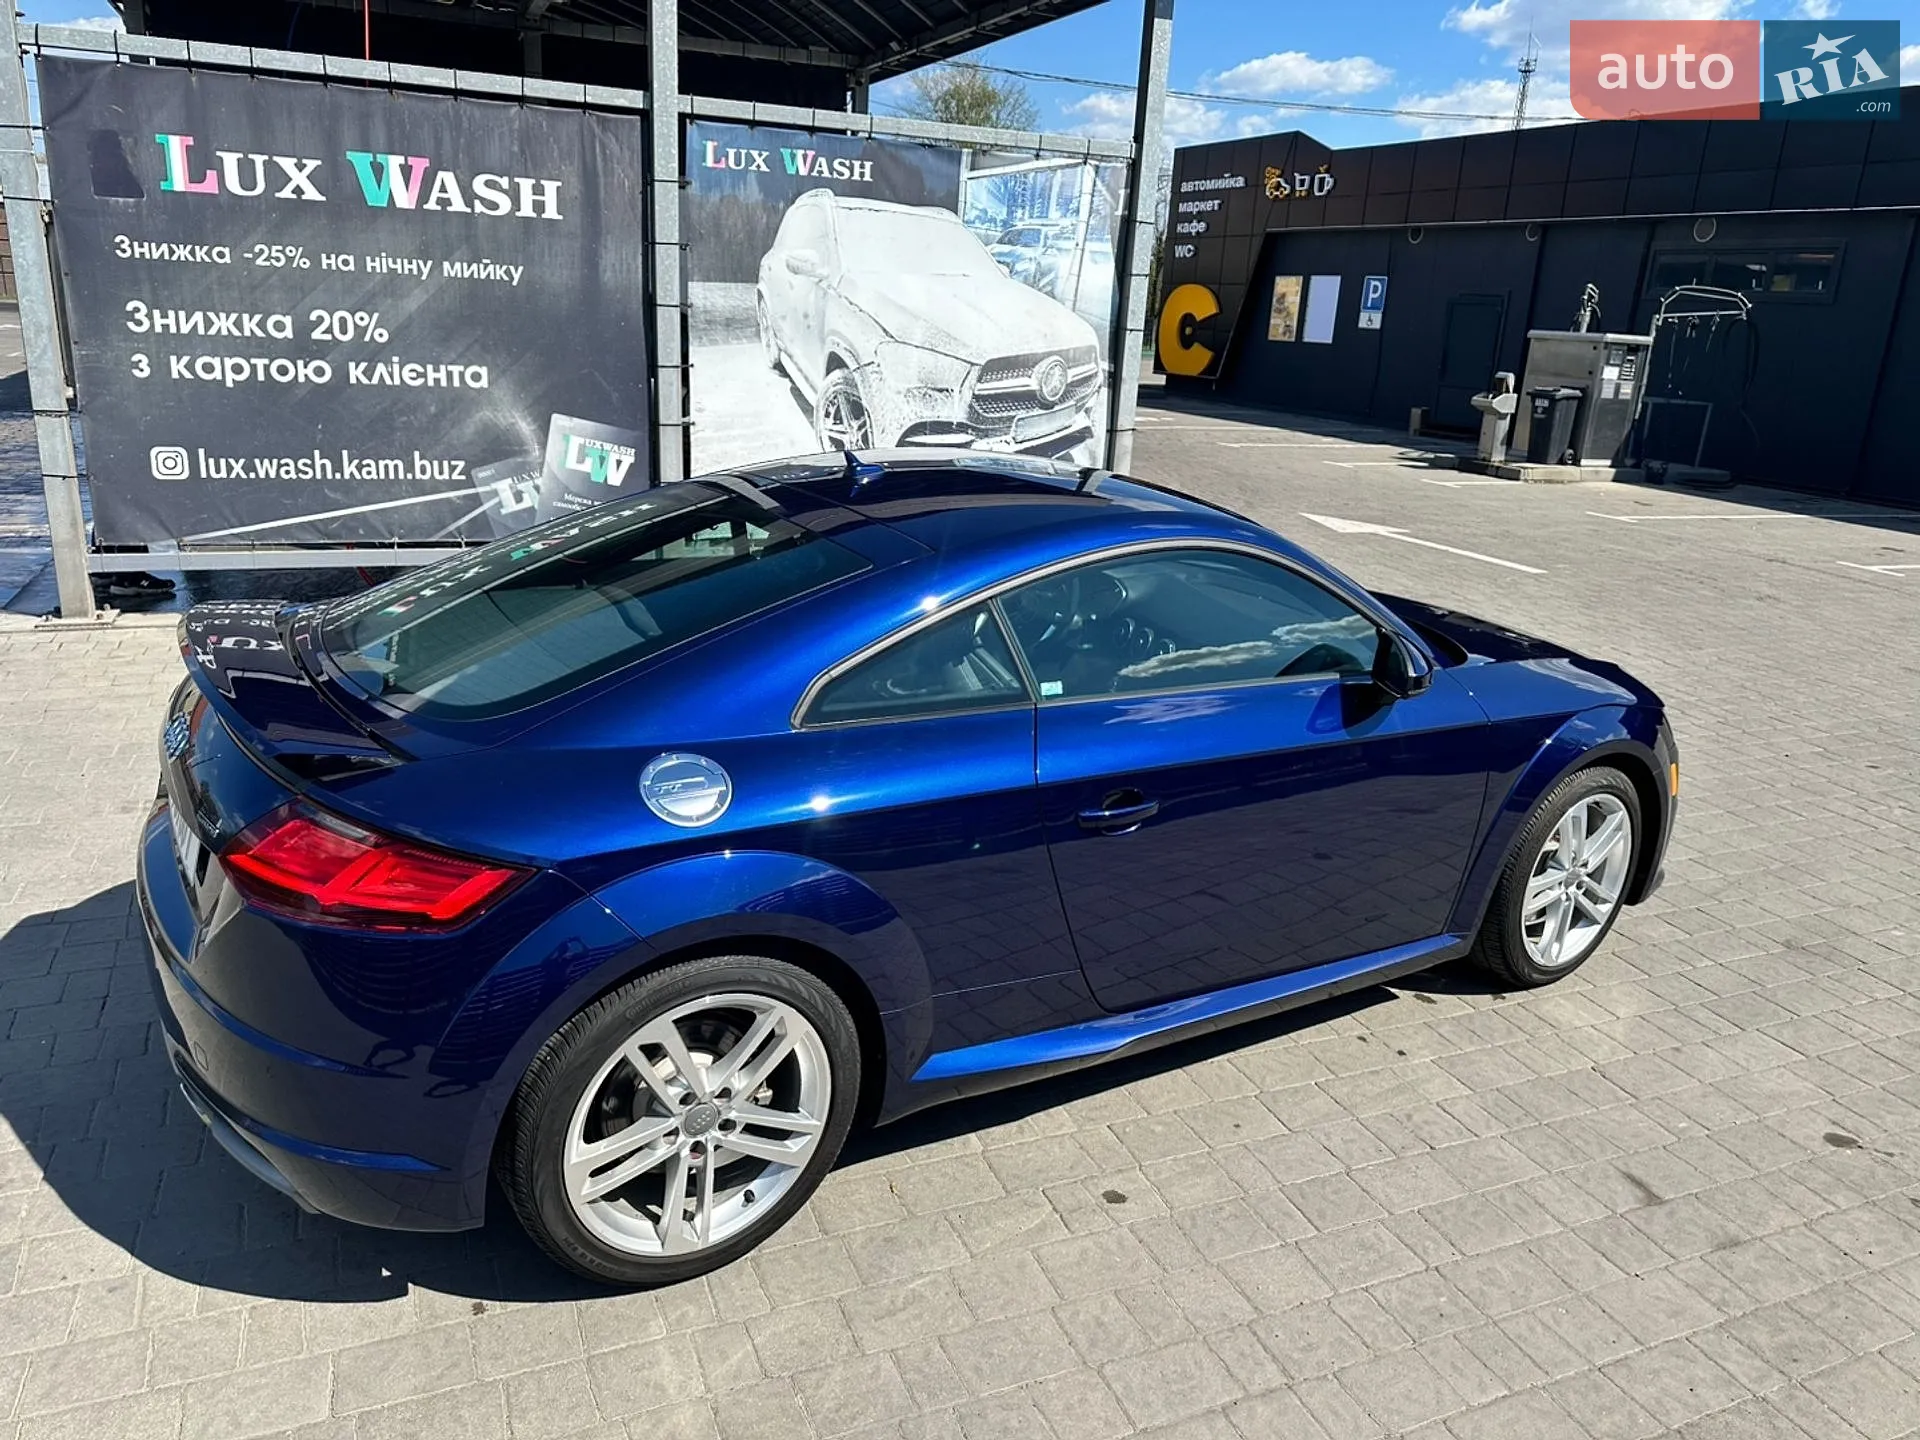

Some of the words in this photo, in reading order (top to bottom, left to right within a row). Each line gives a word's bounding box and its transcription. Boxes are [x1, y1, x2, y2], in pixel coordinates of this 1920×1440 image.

[155, 134, 326, 202] LUX
[346, 150, 565, 220] WASH
[702, 140, 770, 172] LUX
[780, 147, 874, 182] WASH
[1180, 172, 1246, 192] автомийка
[1178, 199, 1221, 214] маркет
[1176, 219, 1207, 236] кафе
[113, 234, 232, 264] Знижка
[242, 244, 311, 269] -25%
[320, 252, 356, 272] на
[365, 251, 434, 280] нічну
[441, 257, 525, 286] мийку
[1174, 244, 1196, 258] WC
[1367, 280, 1382, 308] P
[124, 300, 294, 340] Знижка
[308, 309, 389, 343] 20%
[130, 352, 151, 379] з
[169, 352, 333, 388] картою
[347, 355, 489, 389] клієнта
[198, 448, 467, 481] lux.wash.kam.buz
